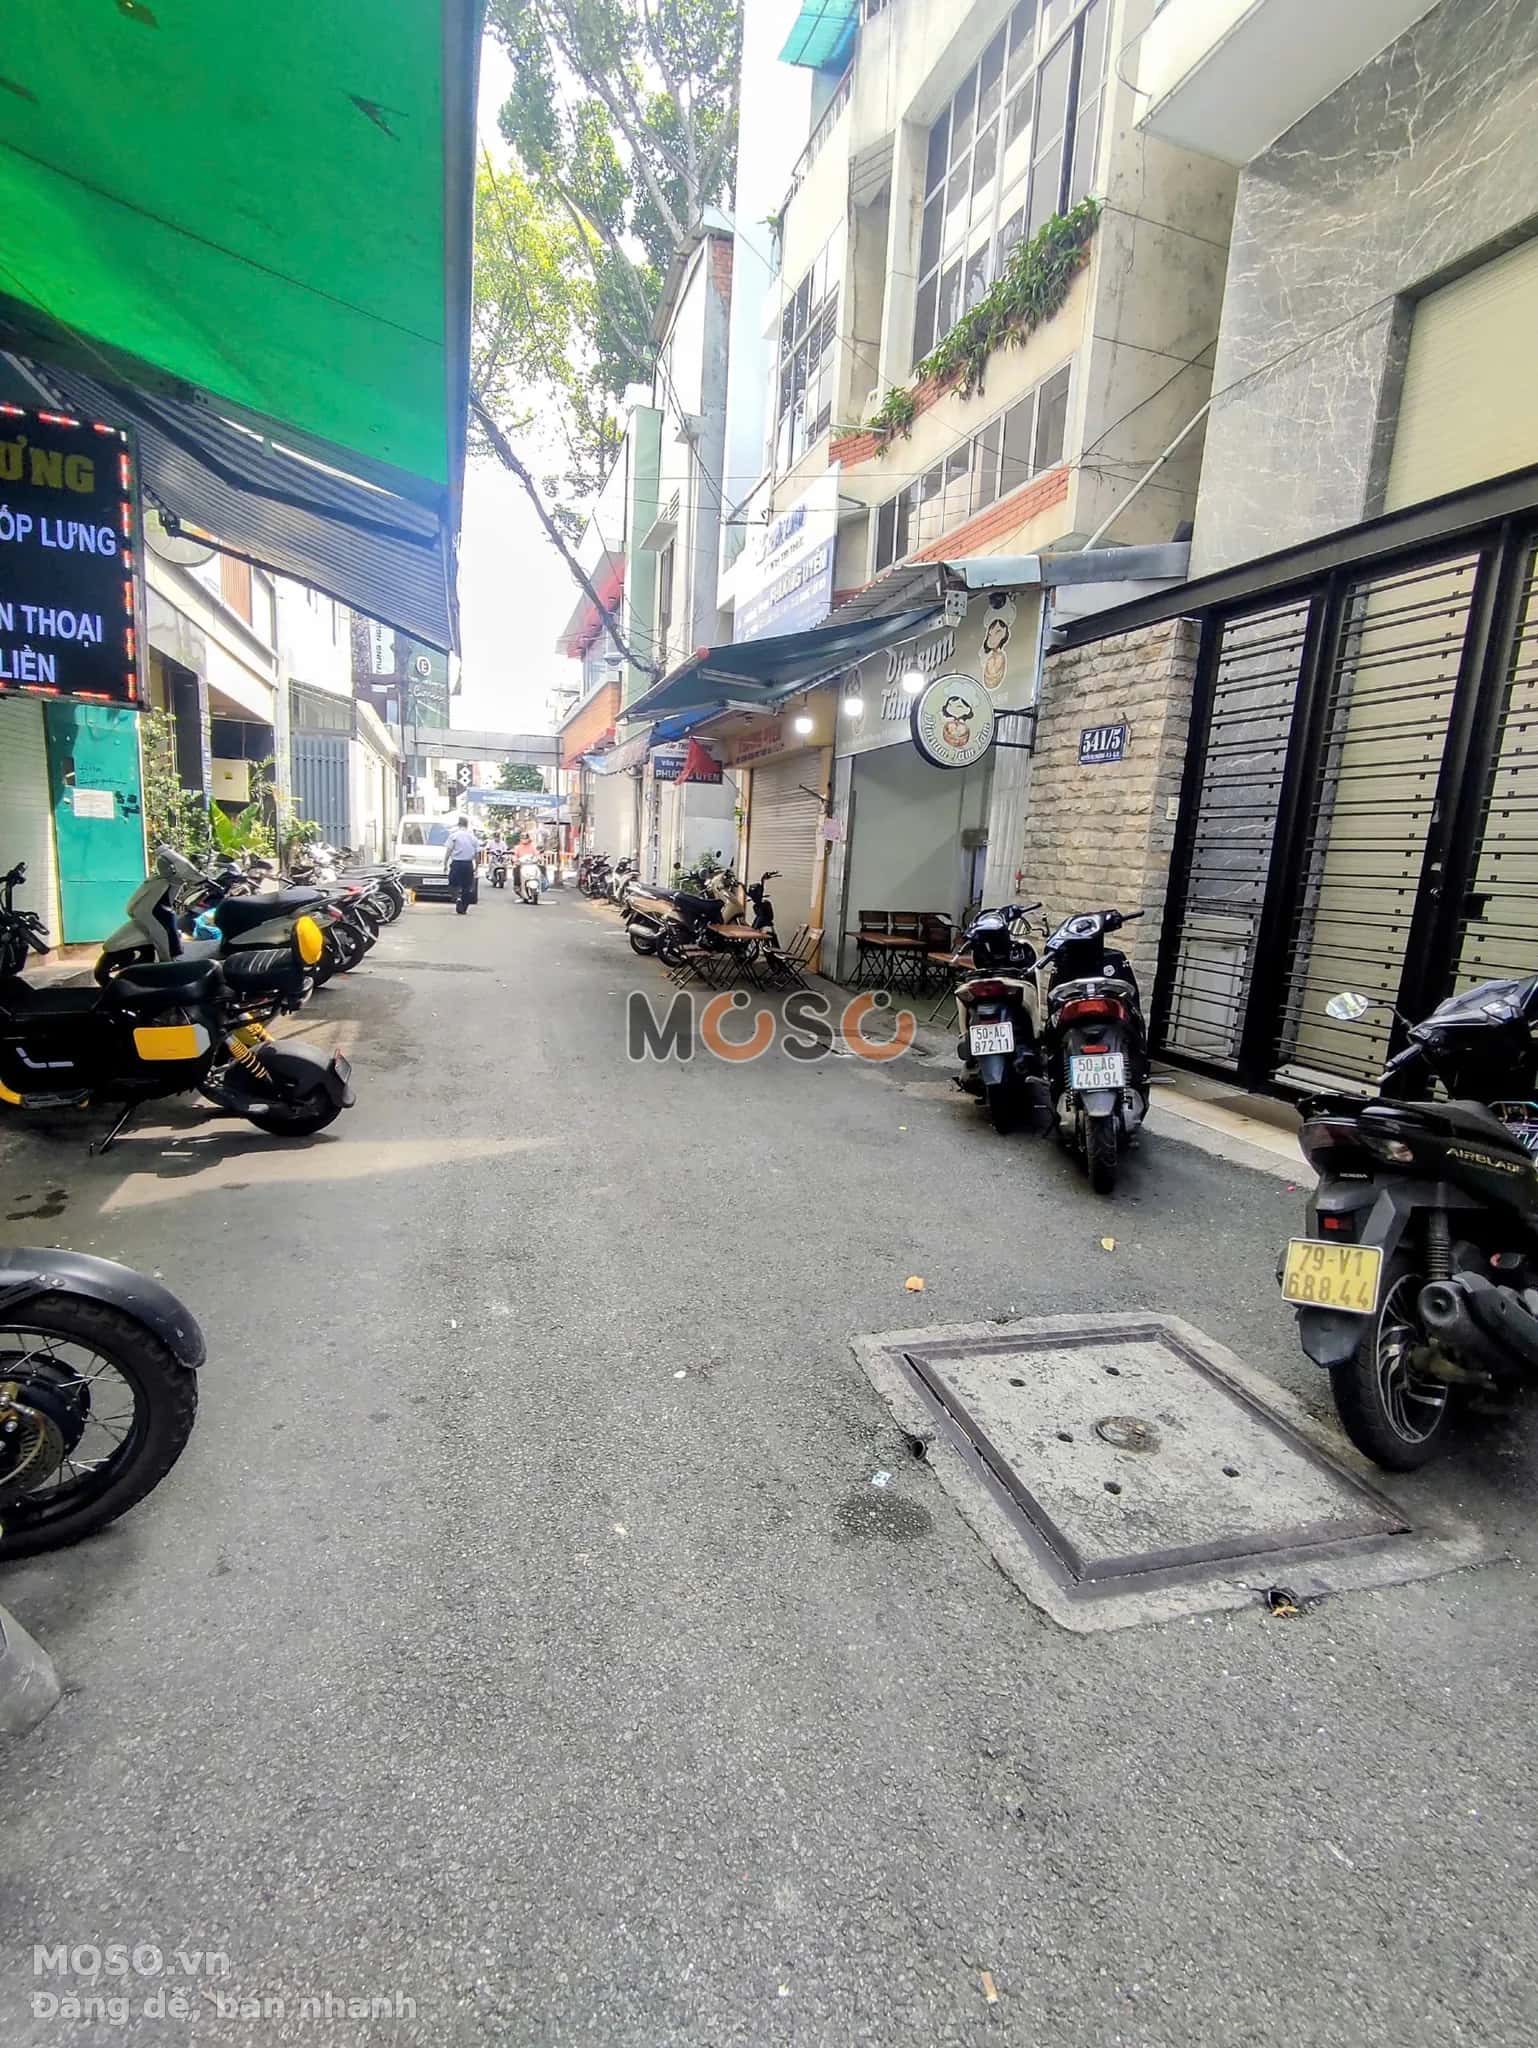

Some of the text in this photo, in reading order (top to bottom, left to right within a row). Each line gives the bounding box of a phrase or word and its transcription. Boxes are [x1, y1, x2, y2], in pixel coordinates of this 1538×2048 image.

[40, 516, 117, 556] LƯNG
[20, 604, 103, 648] THOẠI
[0, 643, 56, 683] LIỀN
[1083, 728, 1122, 753] 541/5
[1076, 1072, 1119, 1088] 440.94
[1078, 1056, 1115, 1072] 50-AG
[1299, 1244, 1363, 1277] 79-V1
[1288, 1272, 1369, 1308] 688.44
